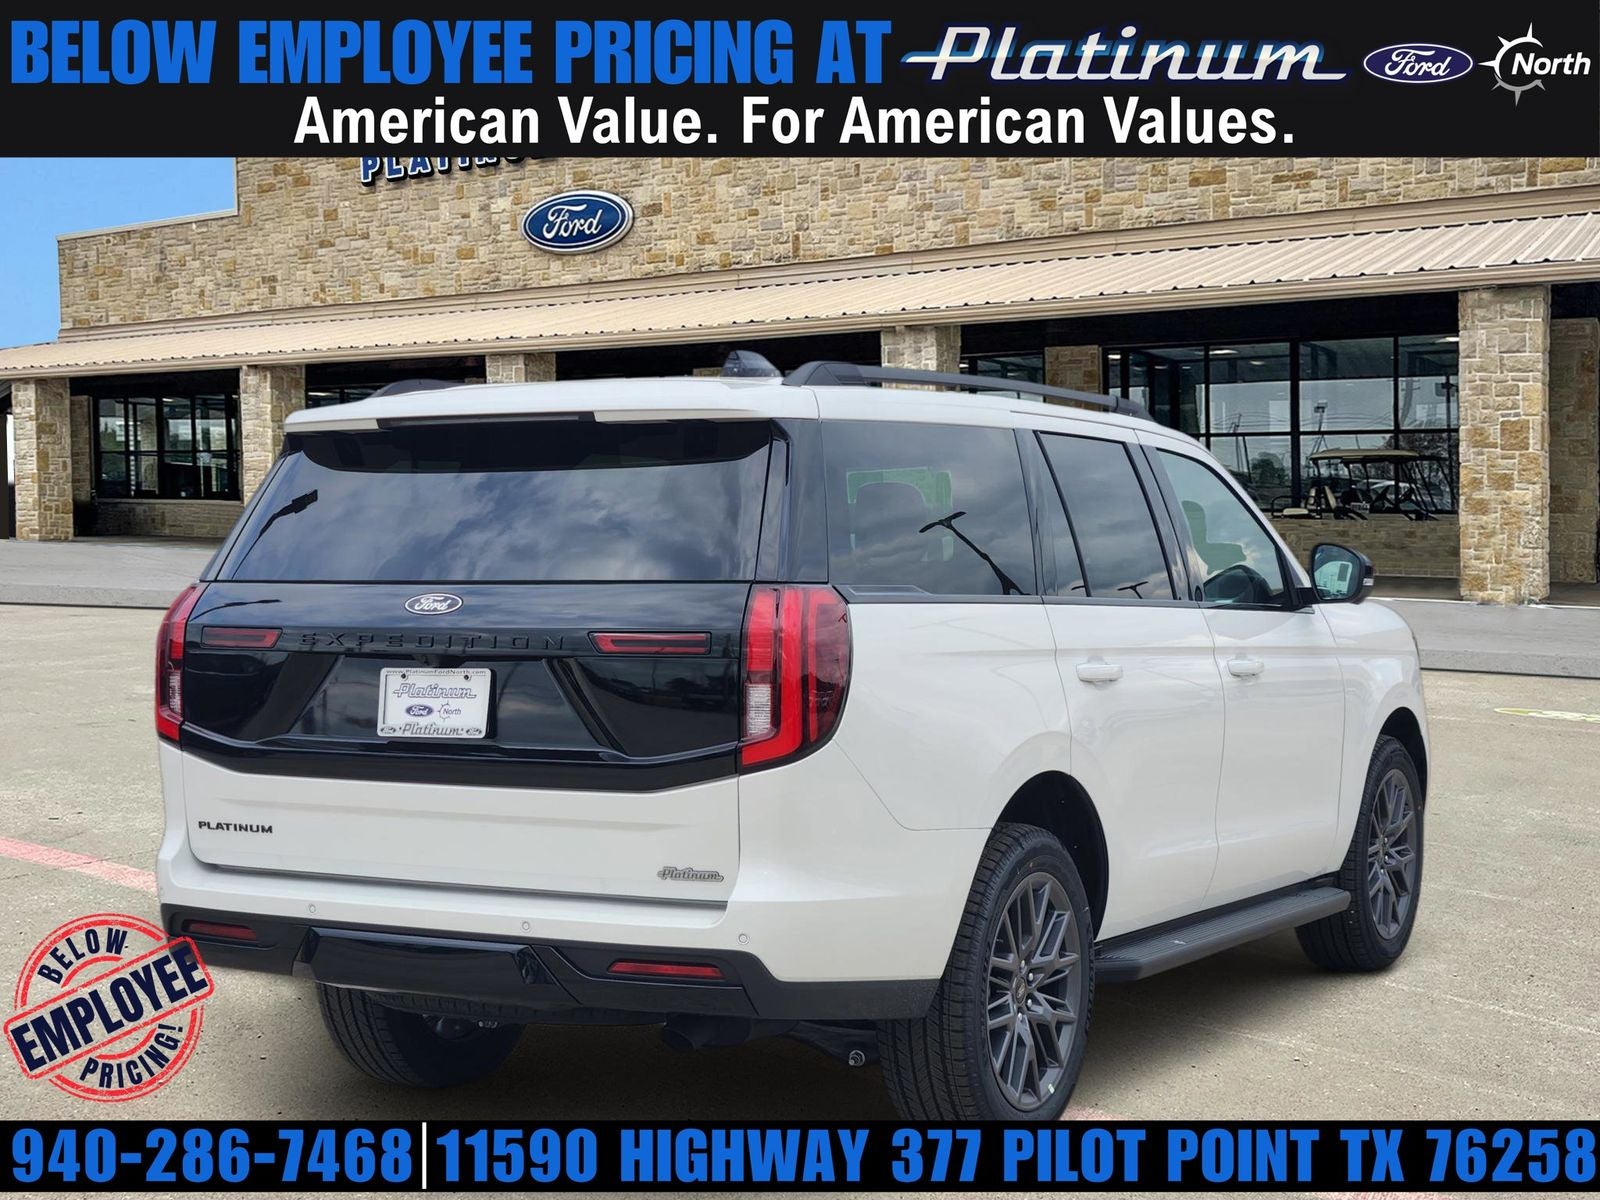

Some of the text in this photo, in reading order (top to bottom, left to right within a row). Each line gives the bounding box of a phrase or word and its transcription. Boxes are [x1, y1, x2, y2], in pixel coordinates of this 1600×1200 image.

[542, 204, 603, 239] Ford
[300, 632, 565, 650] EXPEDITION
[393, 682, 477, 699] Platinum
[443, 706, 462, 715] North
[401, 721, 464, 736] Platinum
[198, 820, 273, 834] PLATINUM
[657, 866, 724, 882] Platinum
